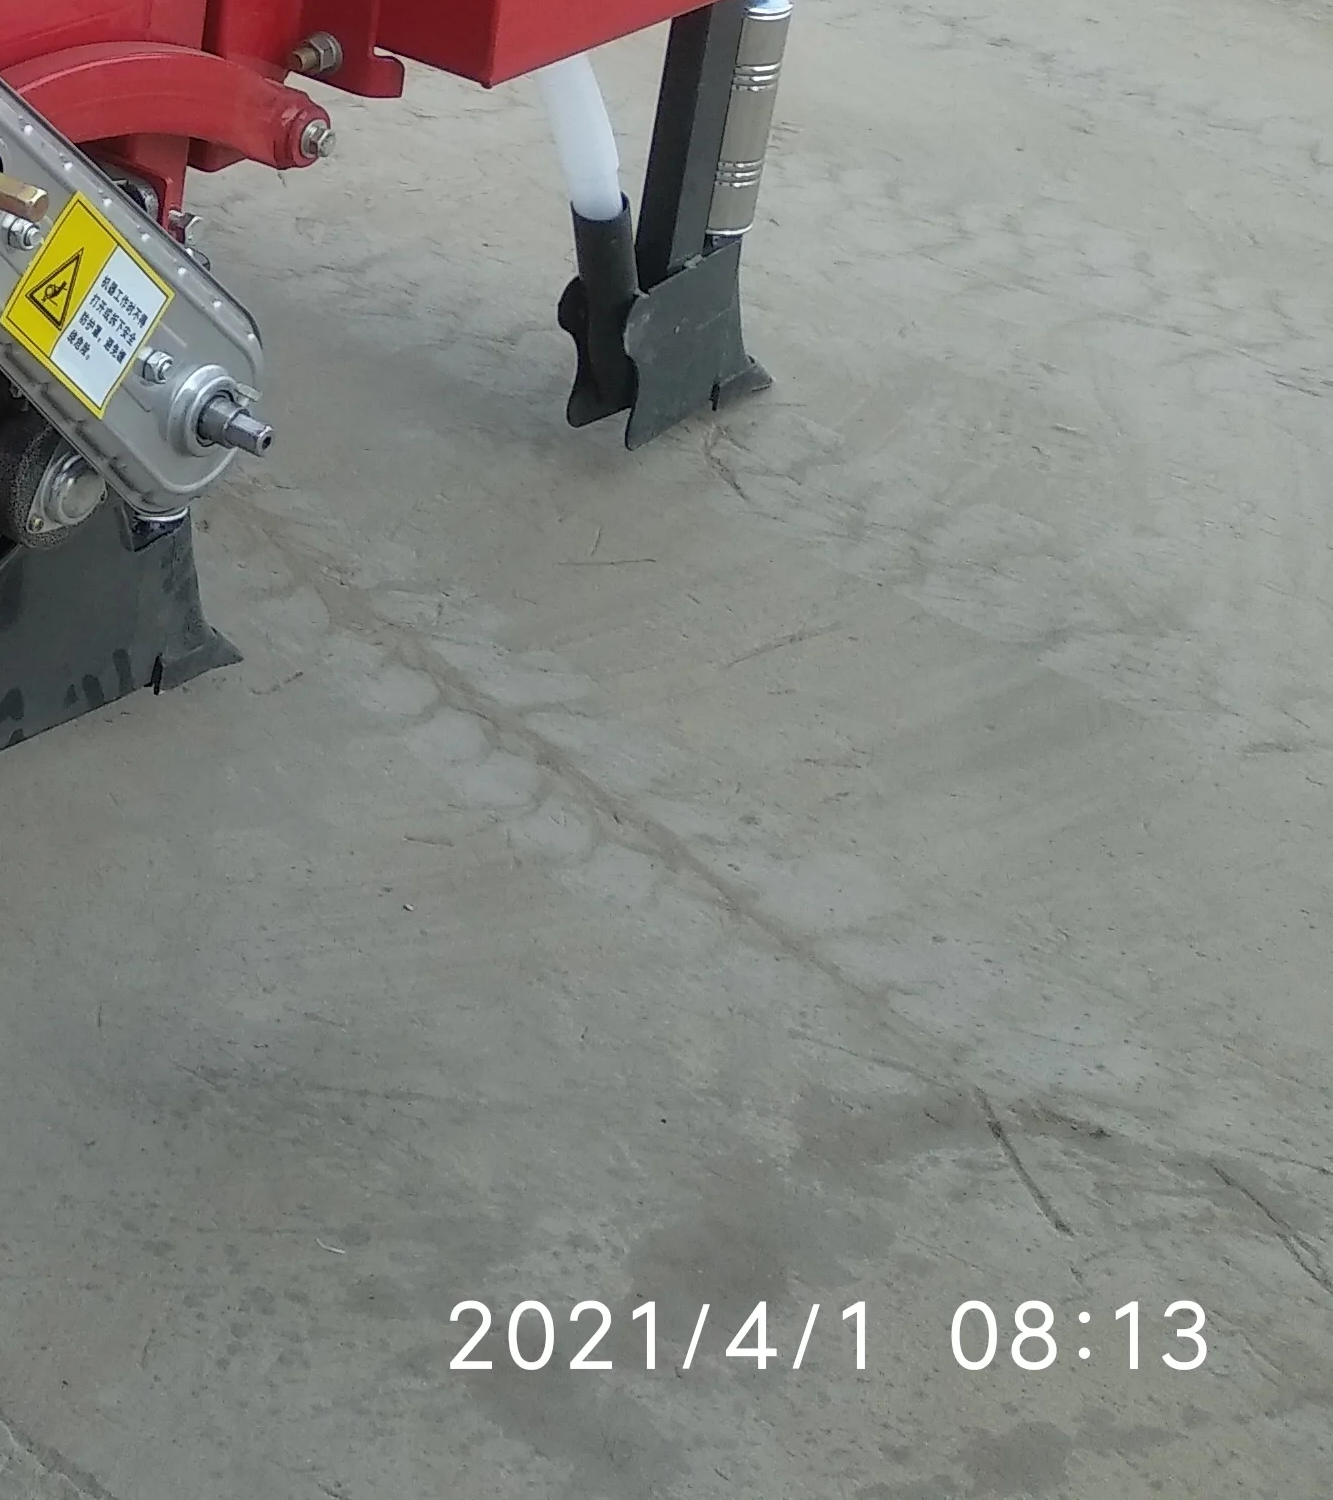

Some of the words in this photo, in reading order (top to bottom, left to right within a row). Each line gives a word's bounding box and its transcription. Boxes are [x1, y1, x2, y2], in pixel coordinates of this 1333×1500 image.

[89, 292, 137, 347] 打开或拆下安全
[100, 274, 149, 329] 机器工作时不得
